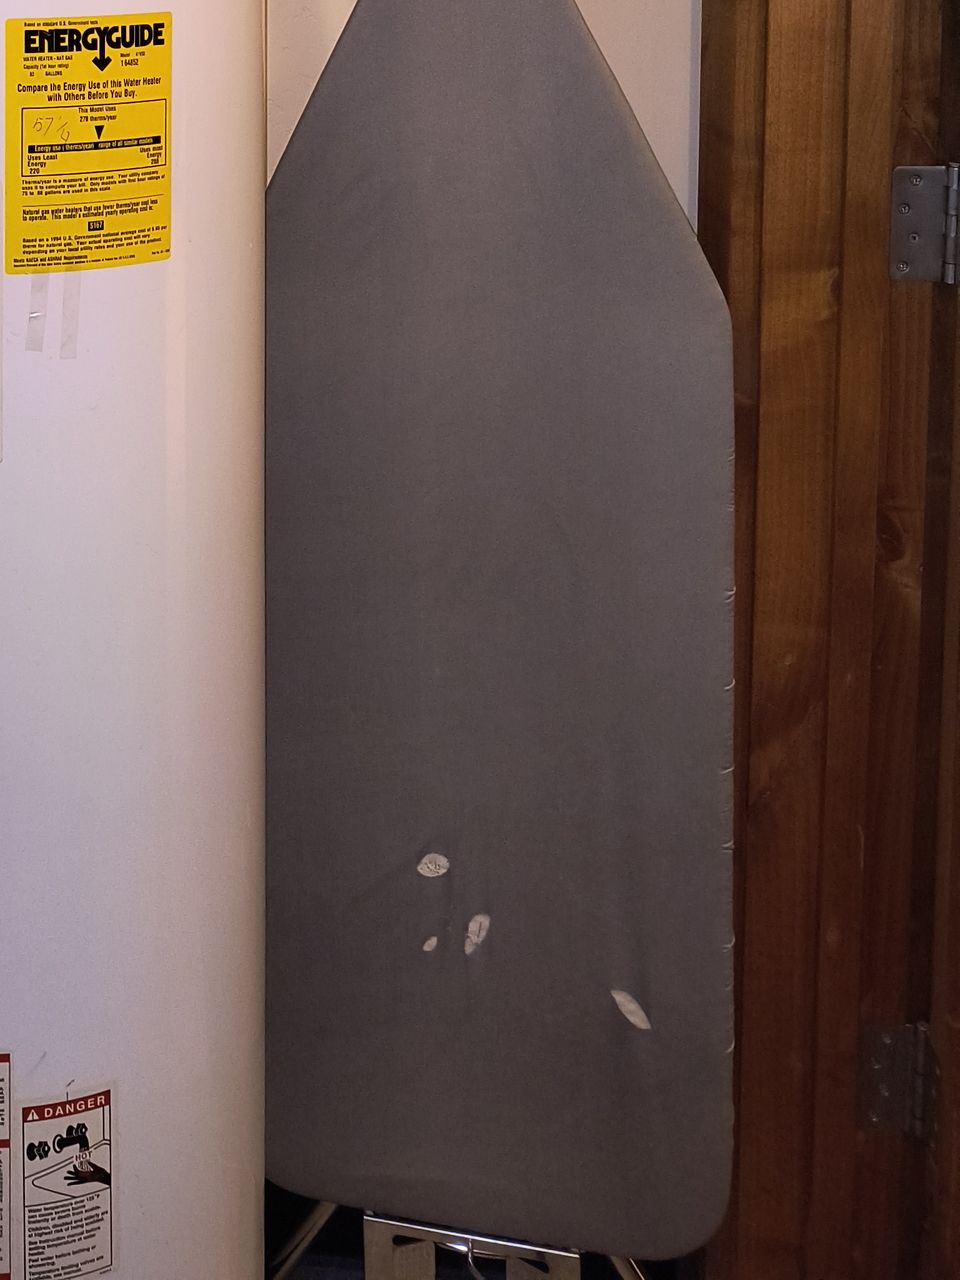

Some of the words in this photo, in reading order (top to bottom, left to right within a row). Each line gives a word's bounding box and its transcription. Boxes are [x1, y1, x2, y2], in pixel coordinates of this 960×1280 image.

[24, 23, 164, 53] ENERGYGUIDE
[18, 82, 48, 93] Compare
[50, 82, 61, 91] the
[64, 82, 86, 93] Energy
[88, 81, 100, 89] Use
[102, 80, 108, 88] of
[110, 79, 121, 88] this
[124, 78, 141, 87] Water
[143, 76, 161, 85] Heater
[48, 93, 61, 102] with
[64, 92, 86, 101] Others
[88, 91, 108, 99] Before
[110, 90, 122, 98] You
[124, 89, 137, 98] Buy.
[45, 1096, 105, 1117] DANGER
[76, 1152, 92, 1161] HOT
